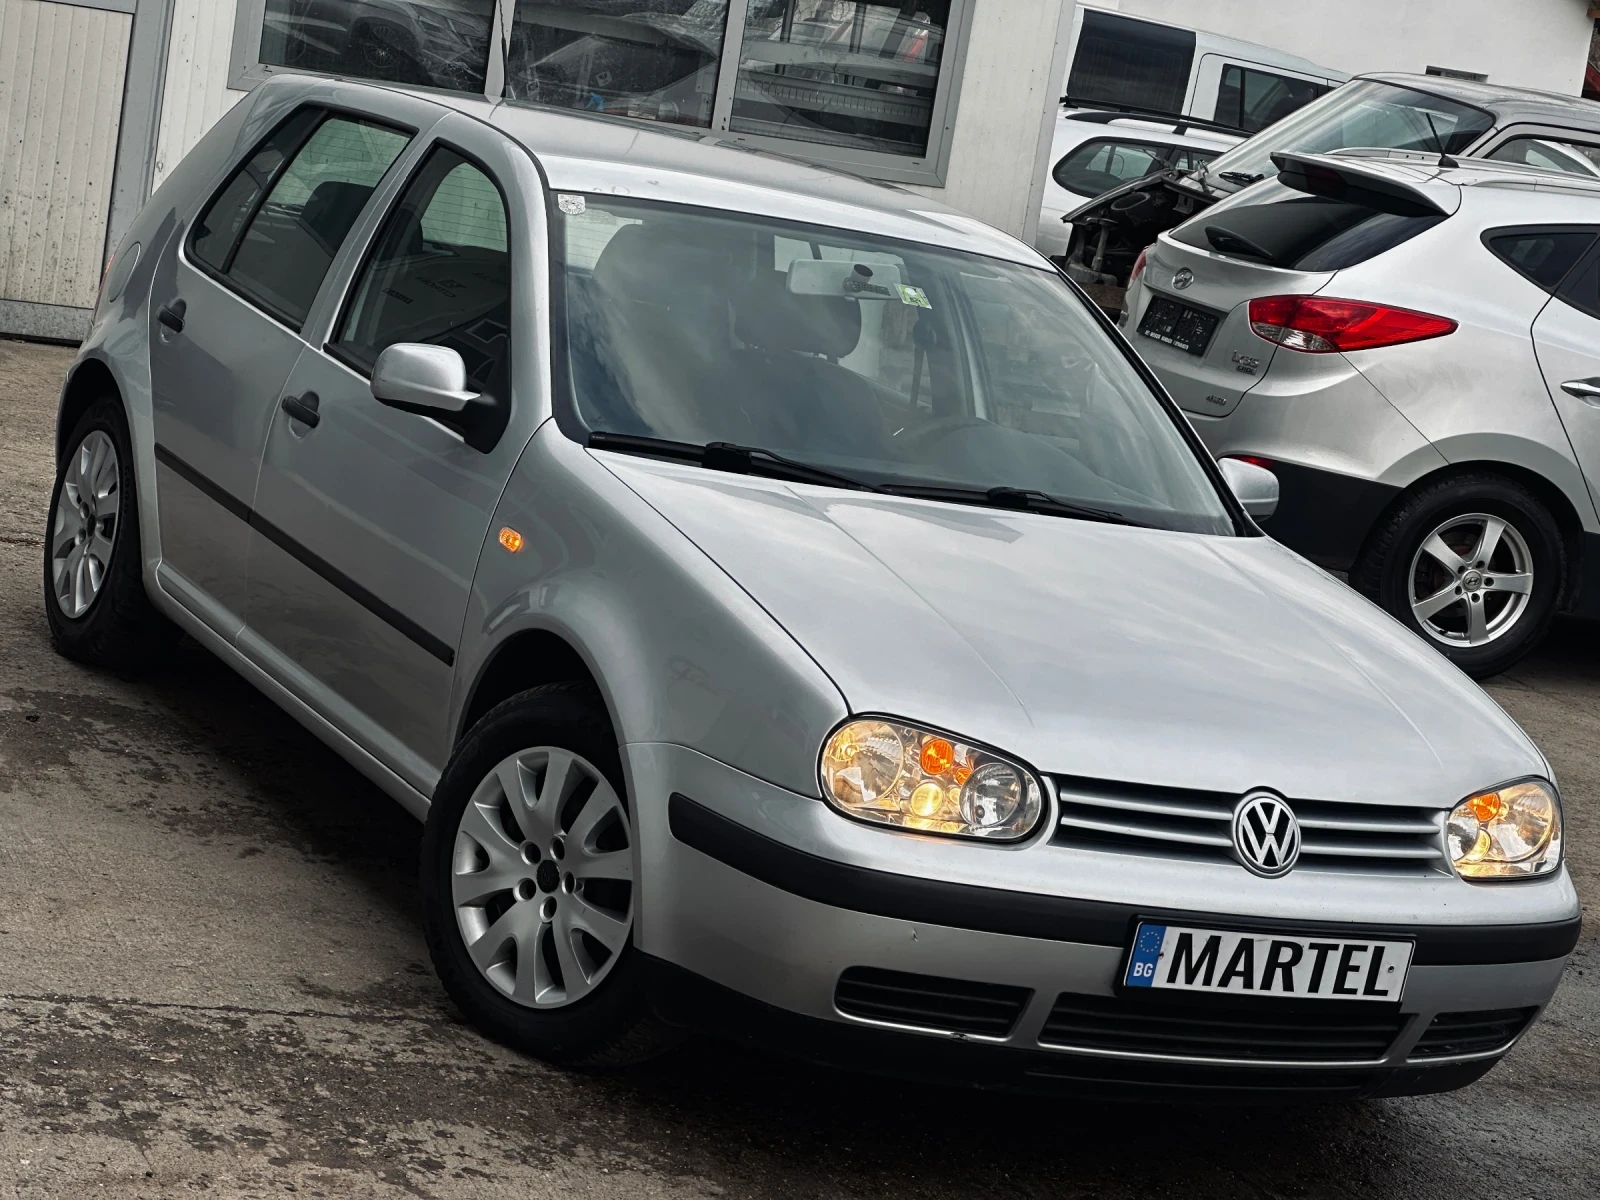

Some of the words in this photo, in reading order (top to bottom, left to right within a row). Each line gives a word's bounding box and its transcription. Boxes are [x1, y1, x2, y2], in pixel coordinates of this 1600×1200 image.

[1238, 797, 1299, 870] VW
[1133, 962, 1153, 977] BG
[1166, 932, 1389, 997] MARTEL
